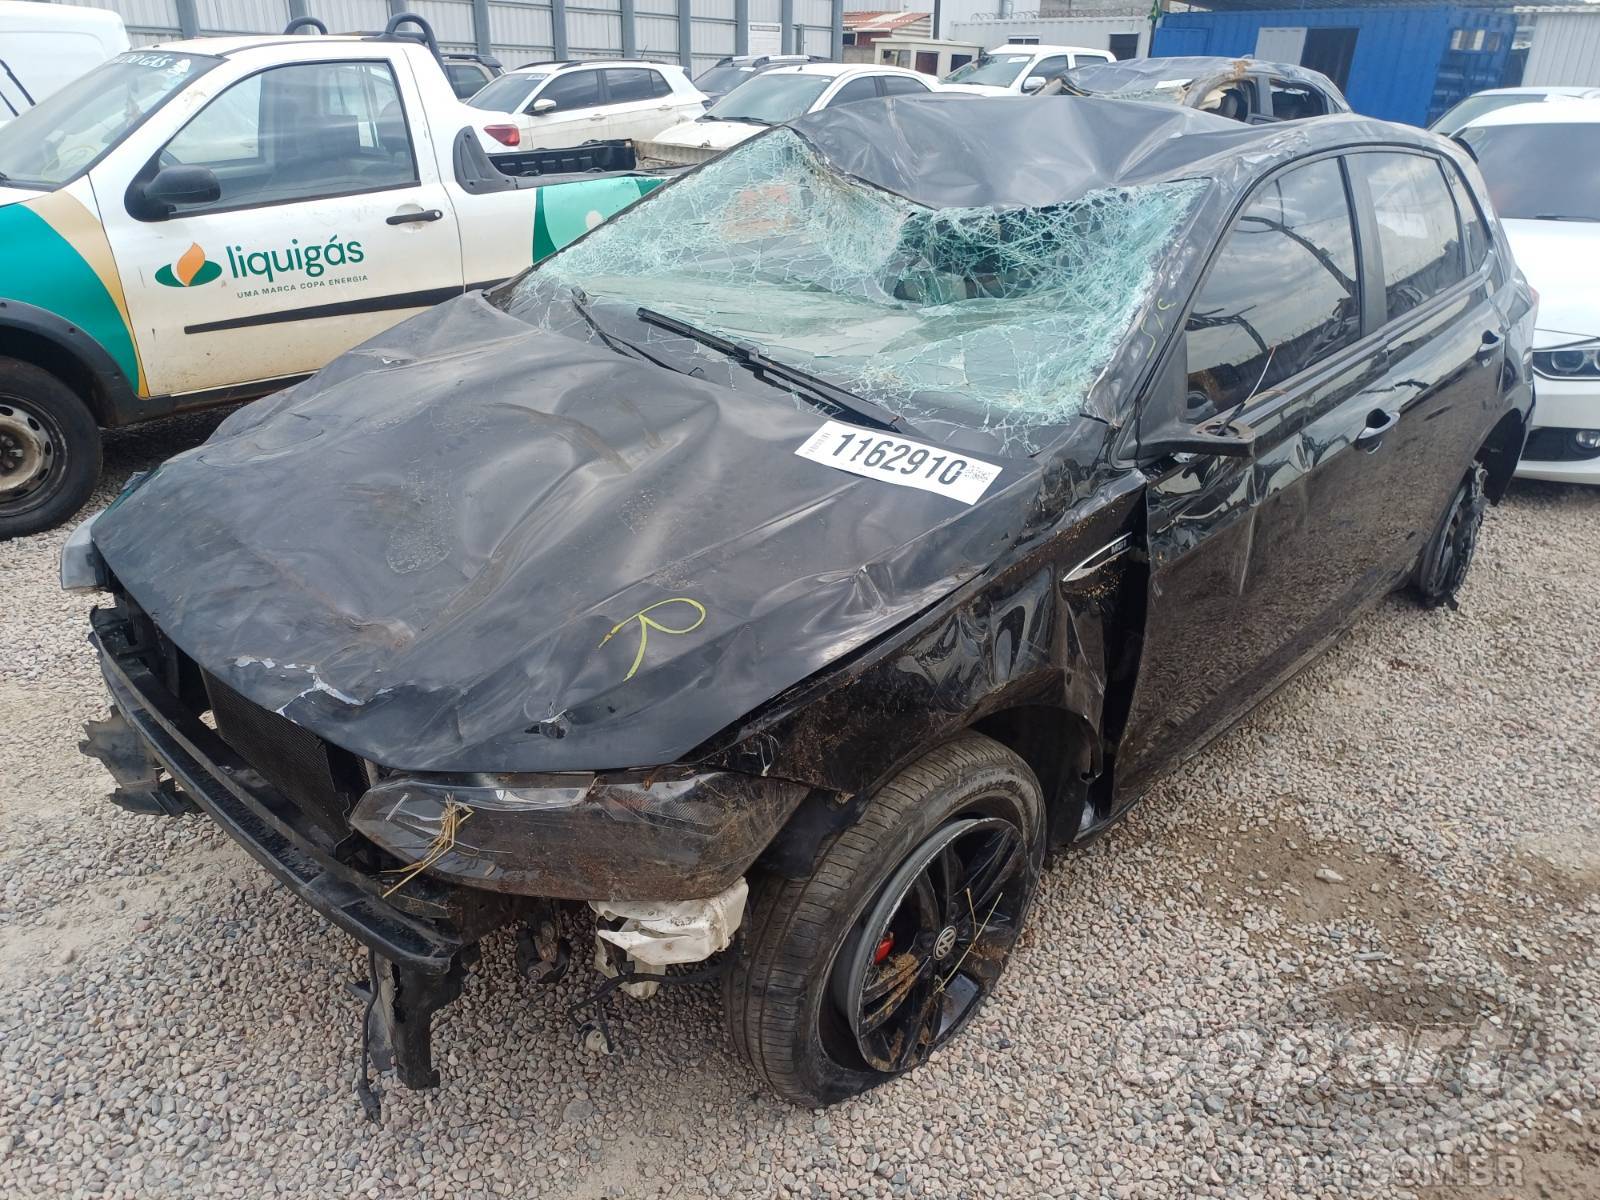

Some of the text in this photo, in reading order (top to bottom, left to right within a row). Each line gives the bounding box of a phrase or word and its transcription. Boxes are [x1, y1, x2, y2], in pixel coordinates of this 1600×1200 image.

[226, 234, 364, 282] liquigás
[237, 275, 368, 299] UMA MARCA COPA ENERGIA
